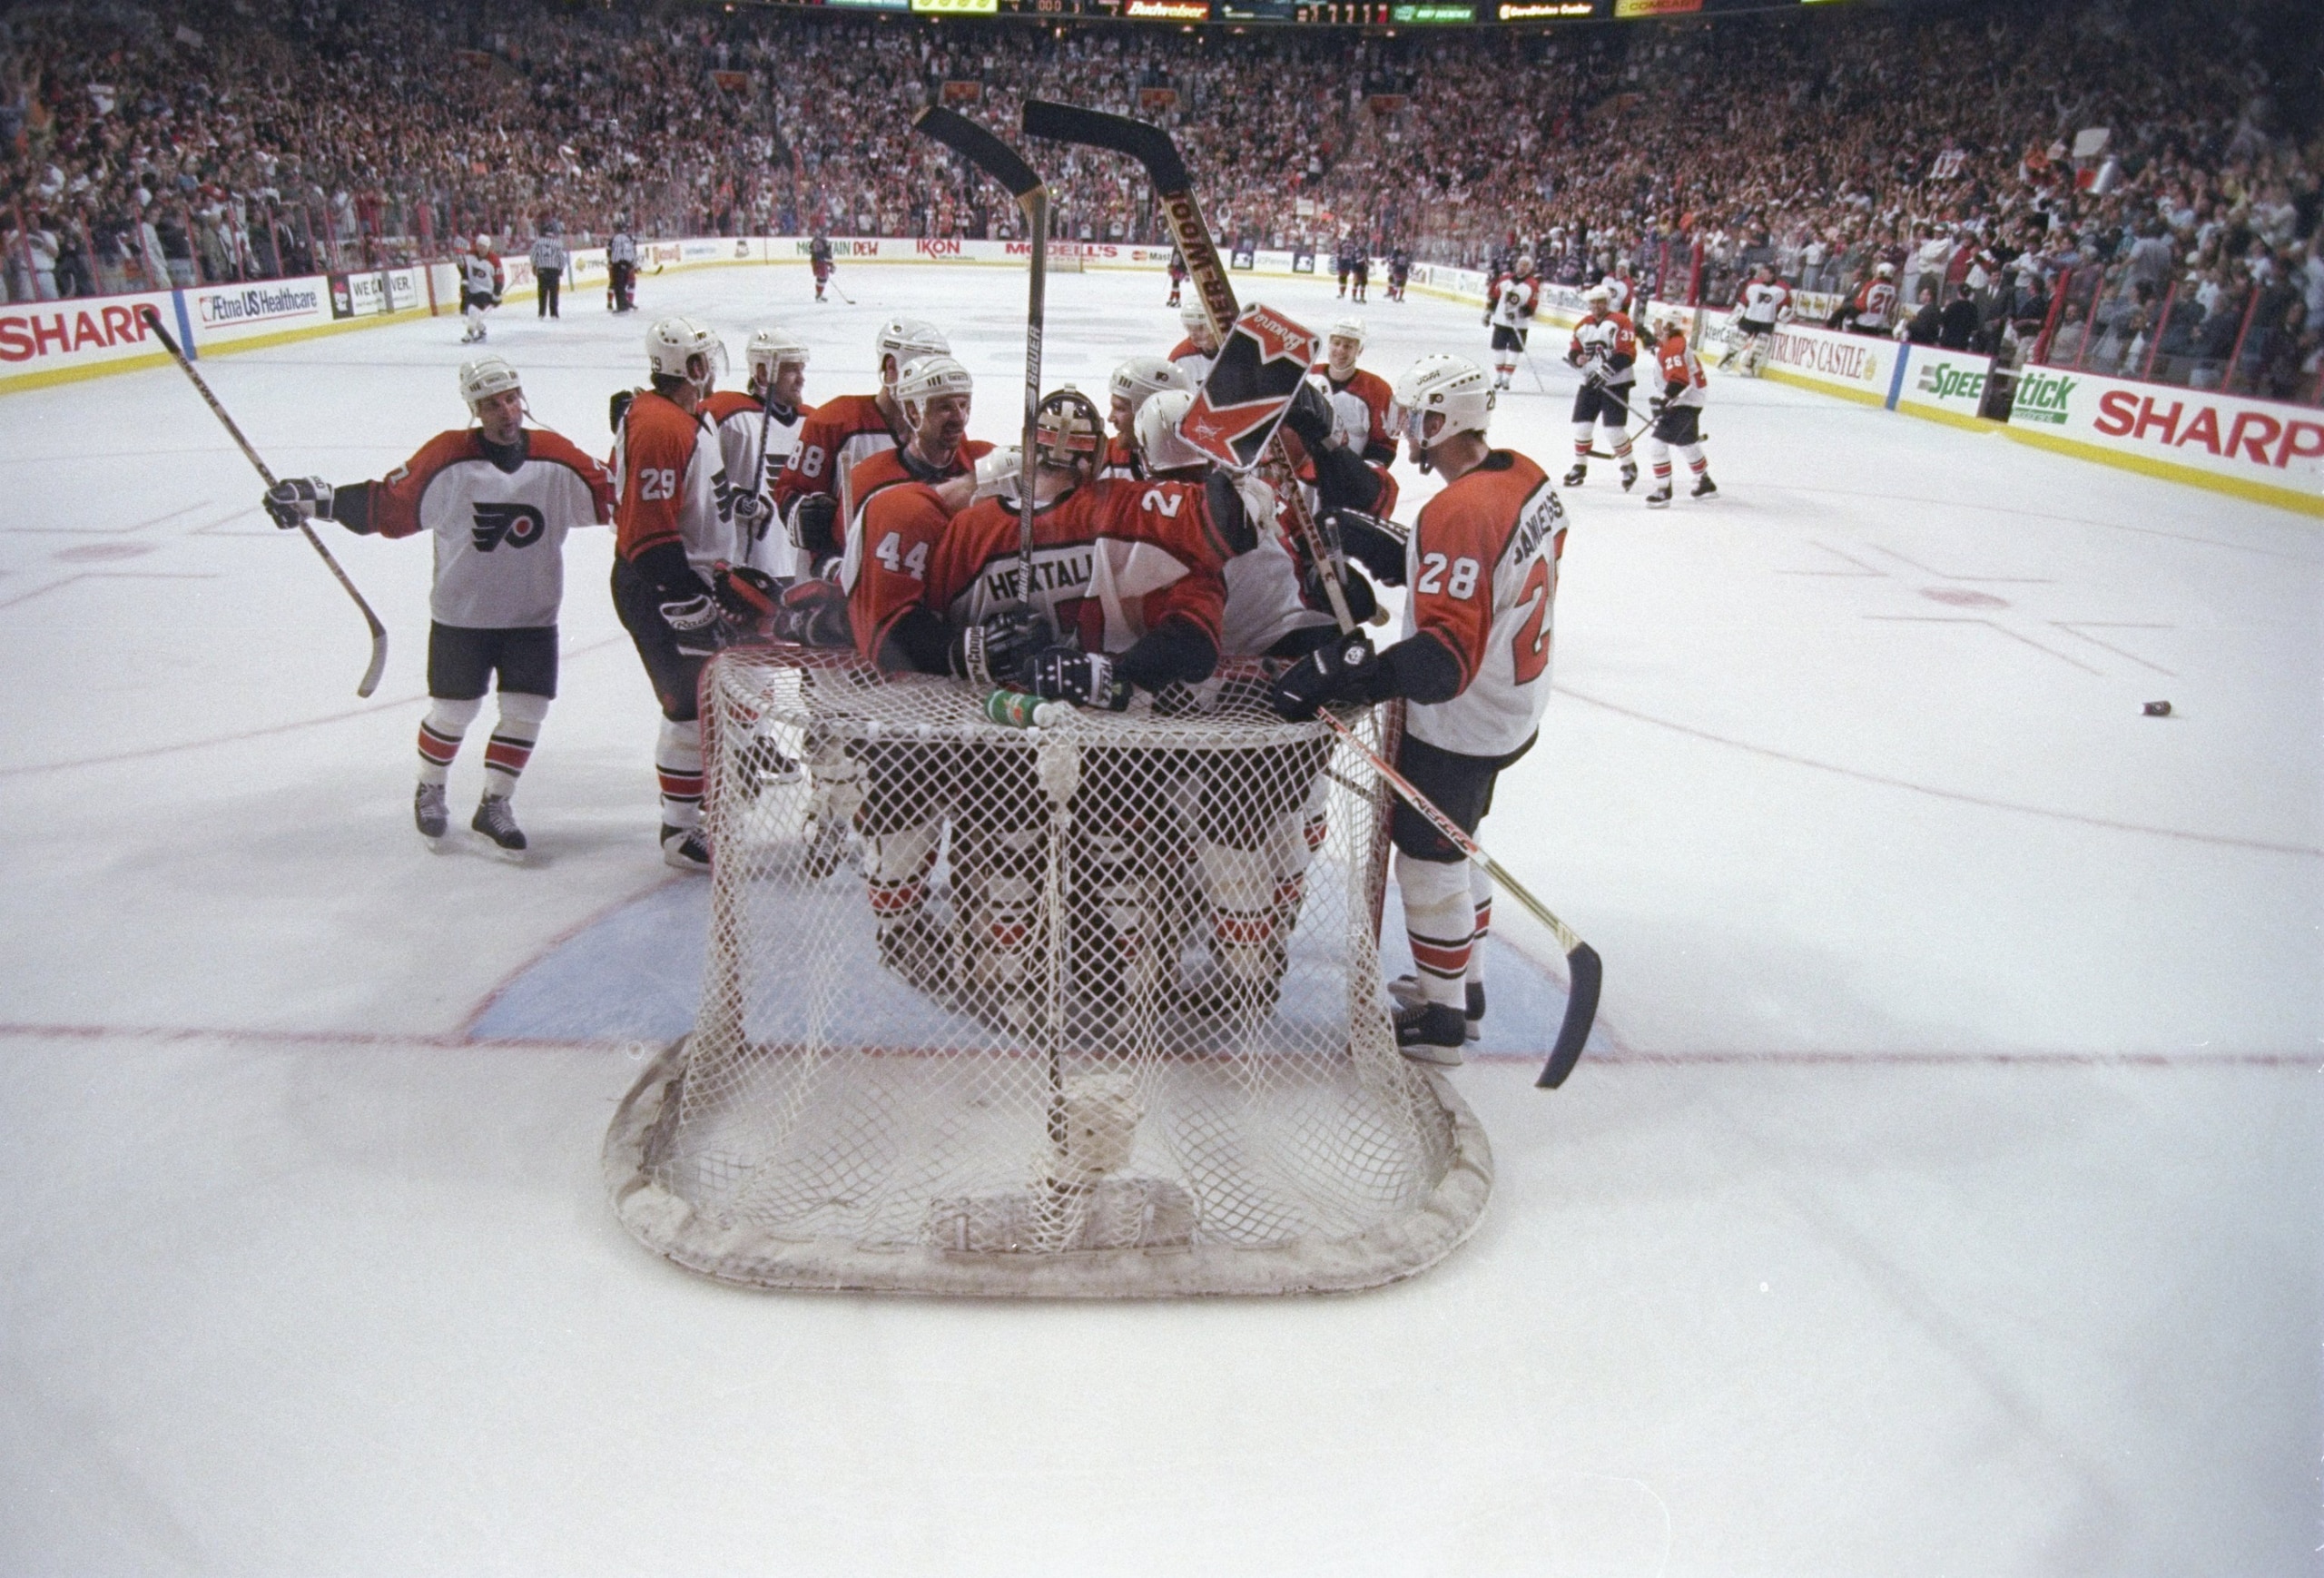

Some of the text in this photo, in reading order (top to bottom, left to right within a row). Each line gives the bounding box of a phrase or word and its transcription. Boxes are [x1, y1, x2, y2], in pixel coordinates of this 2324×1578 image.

[1128, 1, 1207, 17] Budweiser
[852, 242, 879, 256] DEW
[916, 239, 960, 259] IKON
[241, 290, 260, 316] US
[260, 287, 318, 312] Healthcare
[0, 303, 162, 361] SHARP
[1770, 332, 1866, 379] TRUMP'S CASTLE
[2093, 390, 2324, 468] SHARP
[787, 439, 825, 478] 88
[640, 468, 676, 501] 29
[875, 532, 929, 581] 44
[1418, 552, 1480, 600] 28
